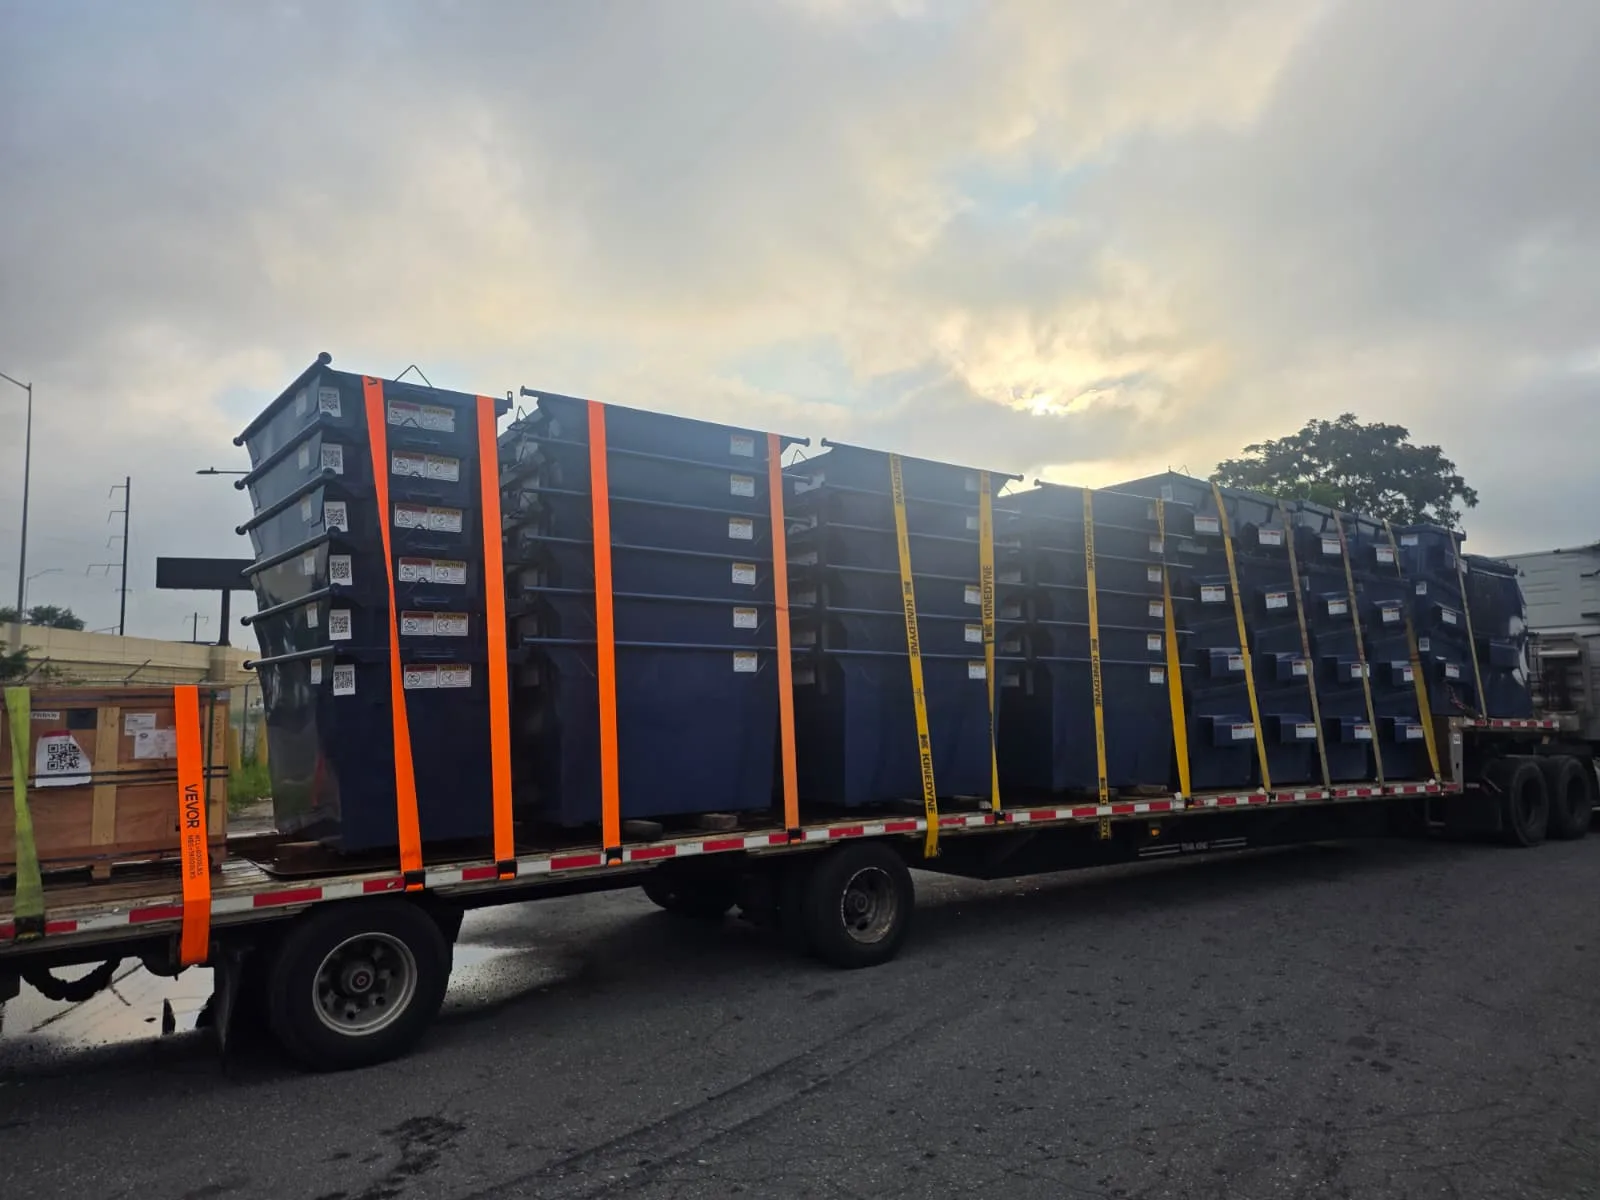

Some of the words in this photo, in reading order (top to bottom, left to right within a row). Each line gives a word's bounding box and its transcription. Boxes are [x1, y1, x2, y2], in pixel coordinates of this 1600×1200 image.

[983, 565, 993, 615] KINEDYNE
[906, 599, 919, 657] KINEDYNE
[1092, 656, 1101, 706] KINEDYNE
[185, 784, 199, 829] VEVOR
[922, 753, 936, 815] KINEDYNE
